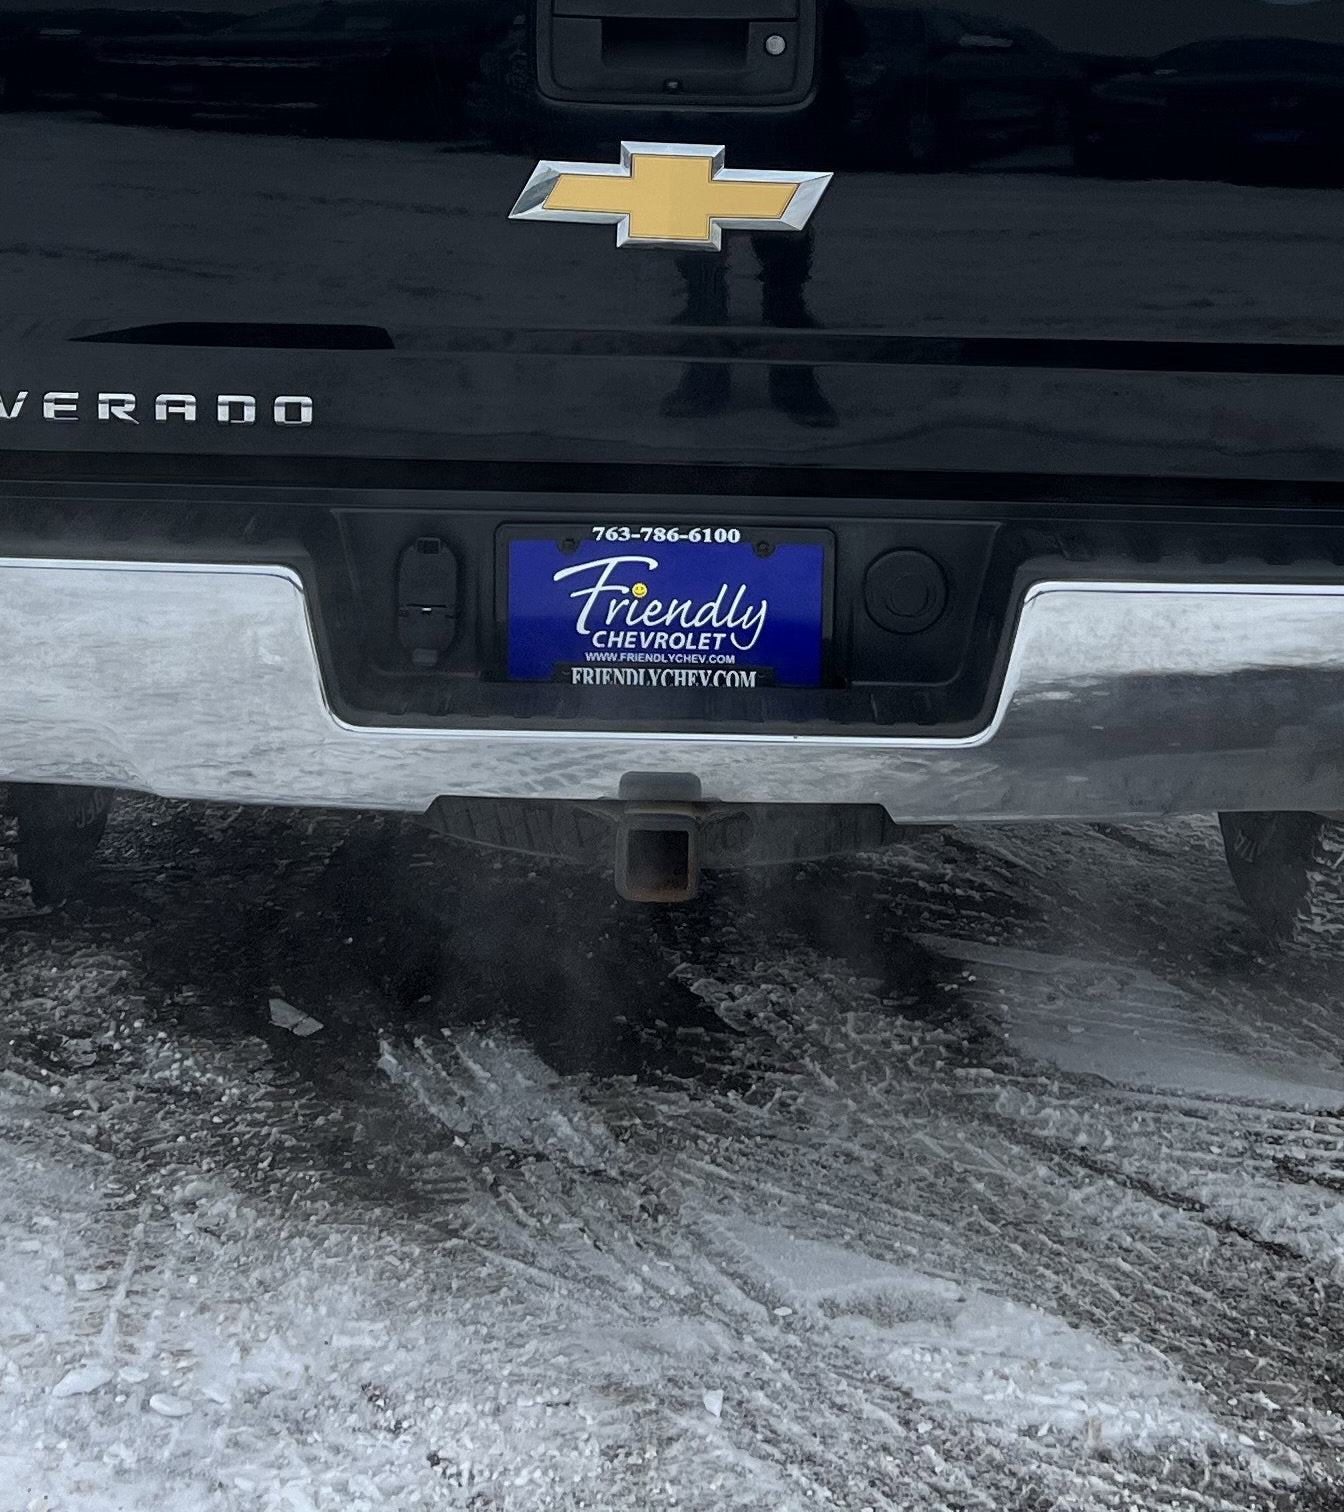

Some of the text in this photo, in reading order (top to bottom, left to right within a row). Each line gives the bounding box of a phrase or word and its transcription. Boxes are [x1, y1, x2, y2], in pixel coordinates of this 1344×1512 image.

[592, 526, 741, 544] 763-786-6100
[553, 555, 768, 651] Friendly
[592, 630, 727, 651] CHEVROLET
[584, 651, 736, 665] WWW.FRIENDLYCHEV.COM
